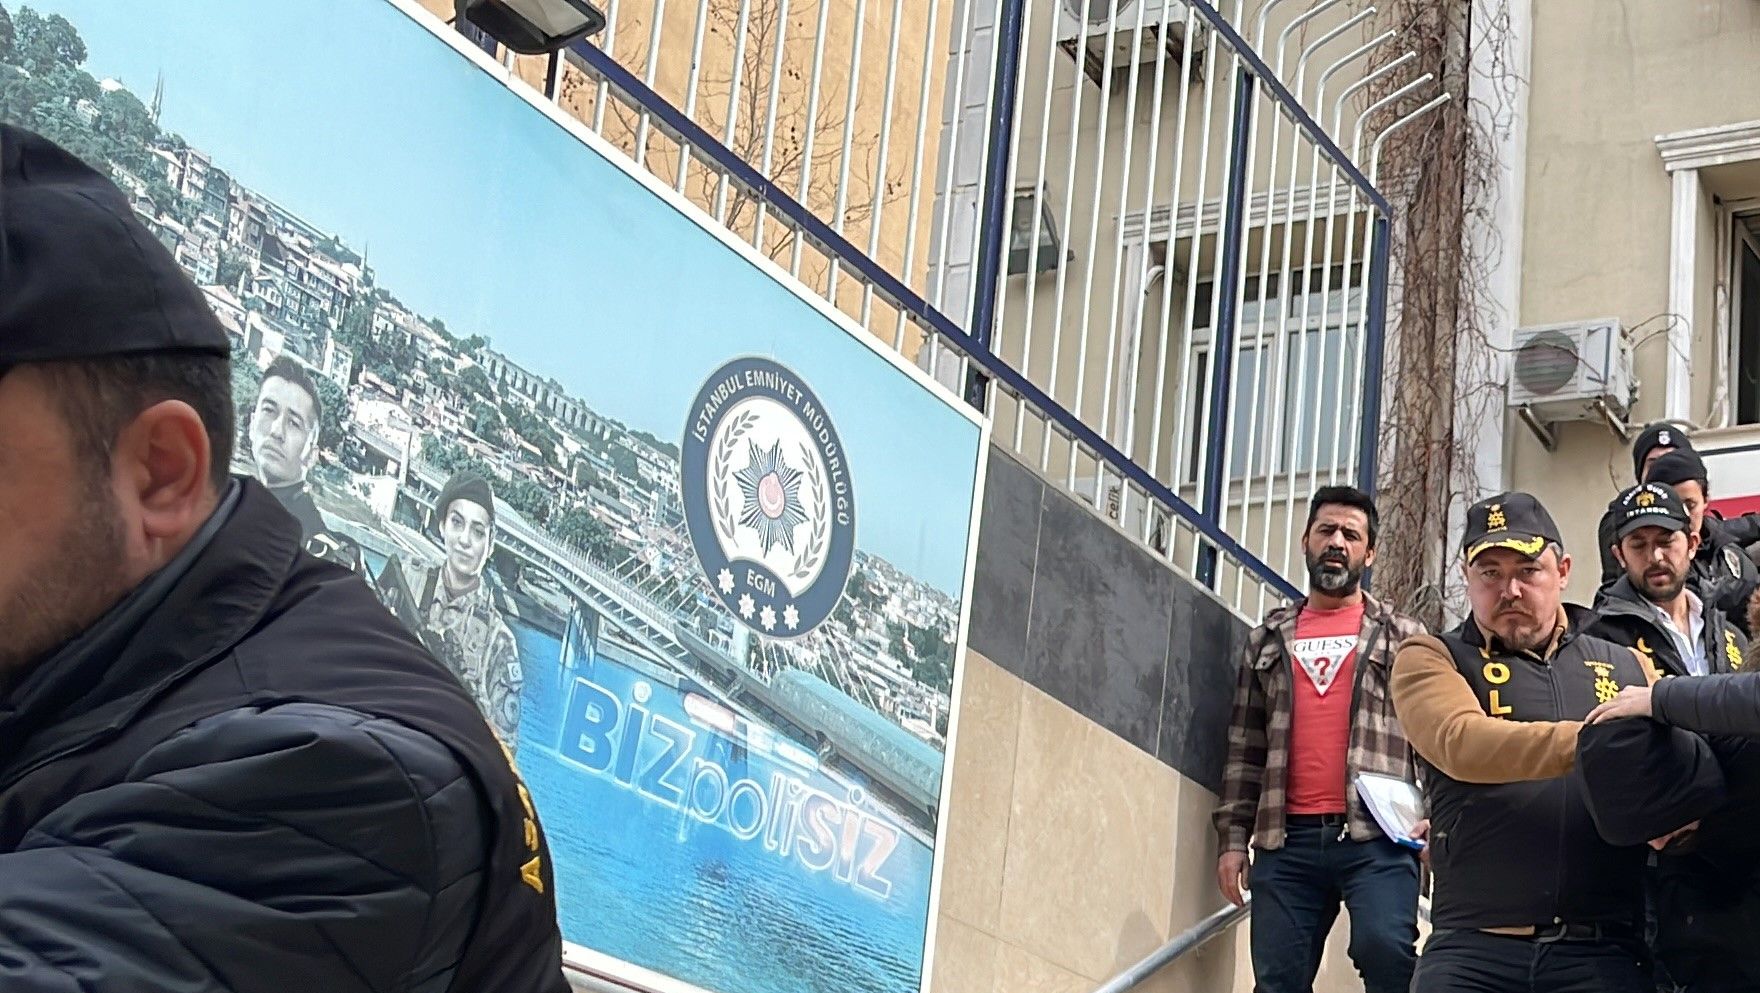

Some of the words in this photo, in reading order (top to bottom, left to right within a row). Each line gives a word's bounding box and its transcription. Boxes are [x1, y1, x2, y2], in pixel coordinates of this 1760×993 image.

[692, 375, 744, 443] İSTANBUL
[745, 370, 803, 405] EMNİYET
[802, 402, 850, 526] MÜDÜRLÜĞÜ
[746, 568, 776, 599] EGM
[1293, 638, 1353, 653] GUESS
